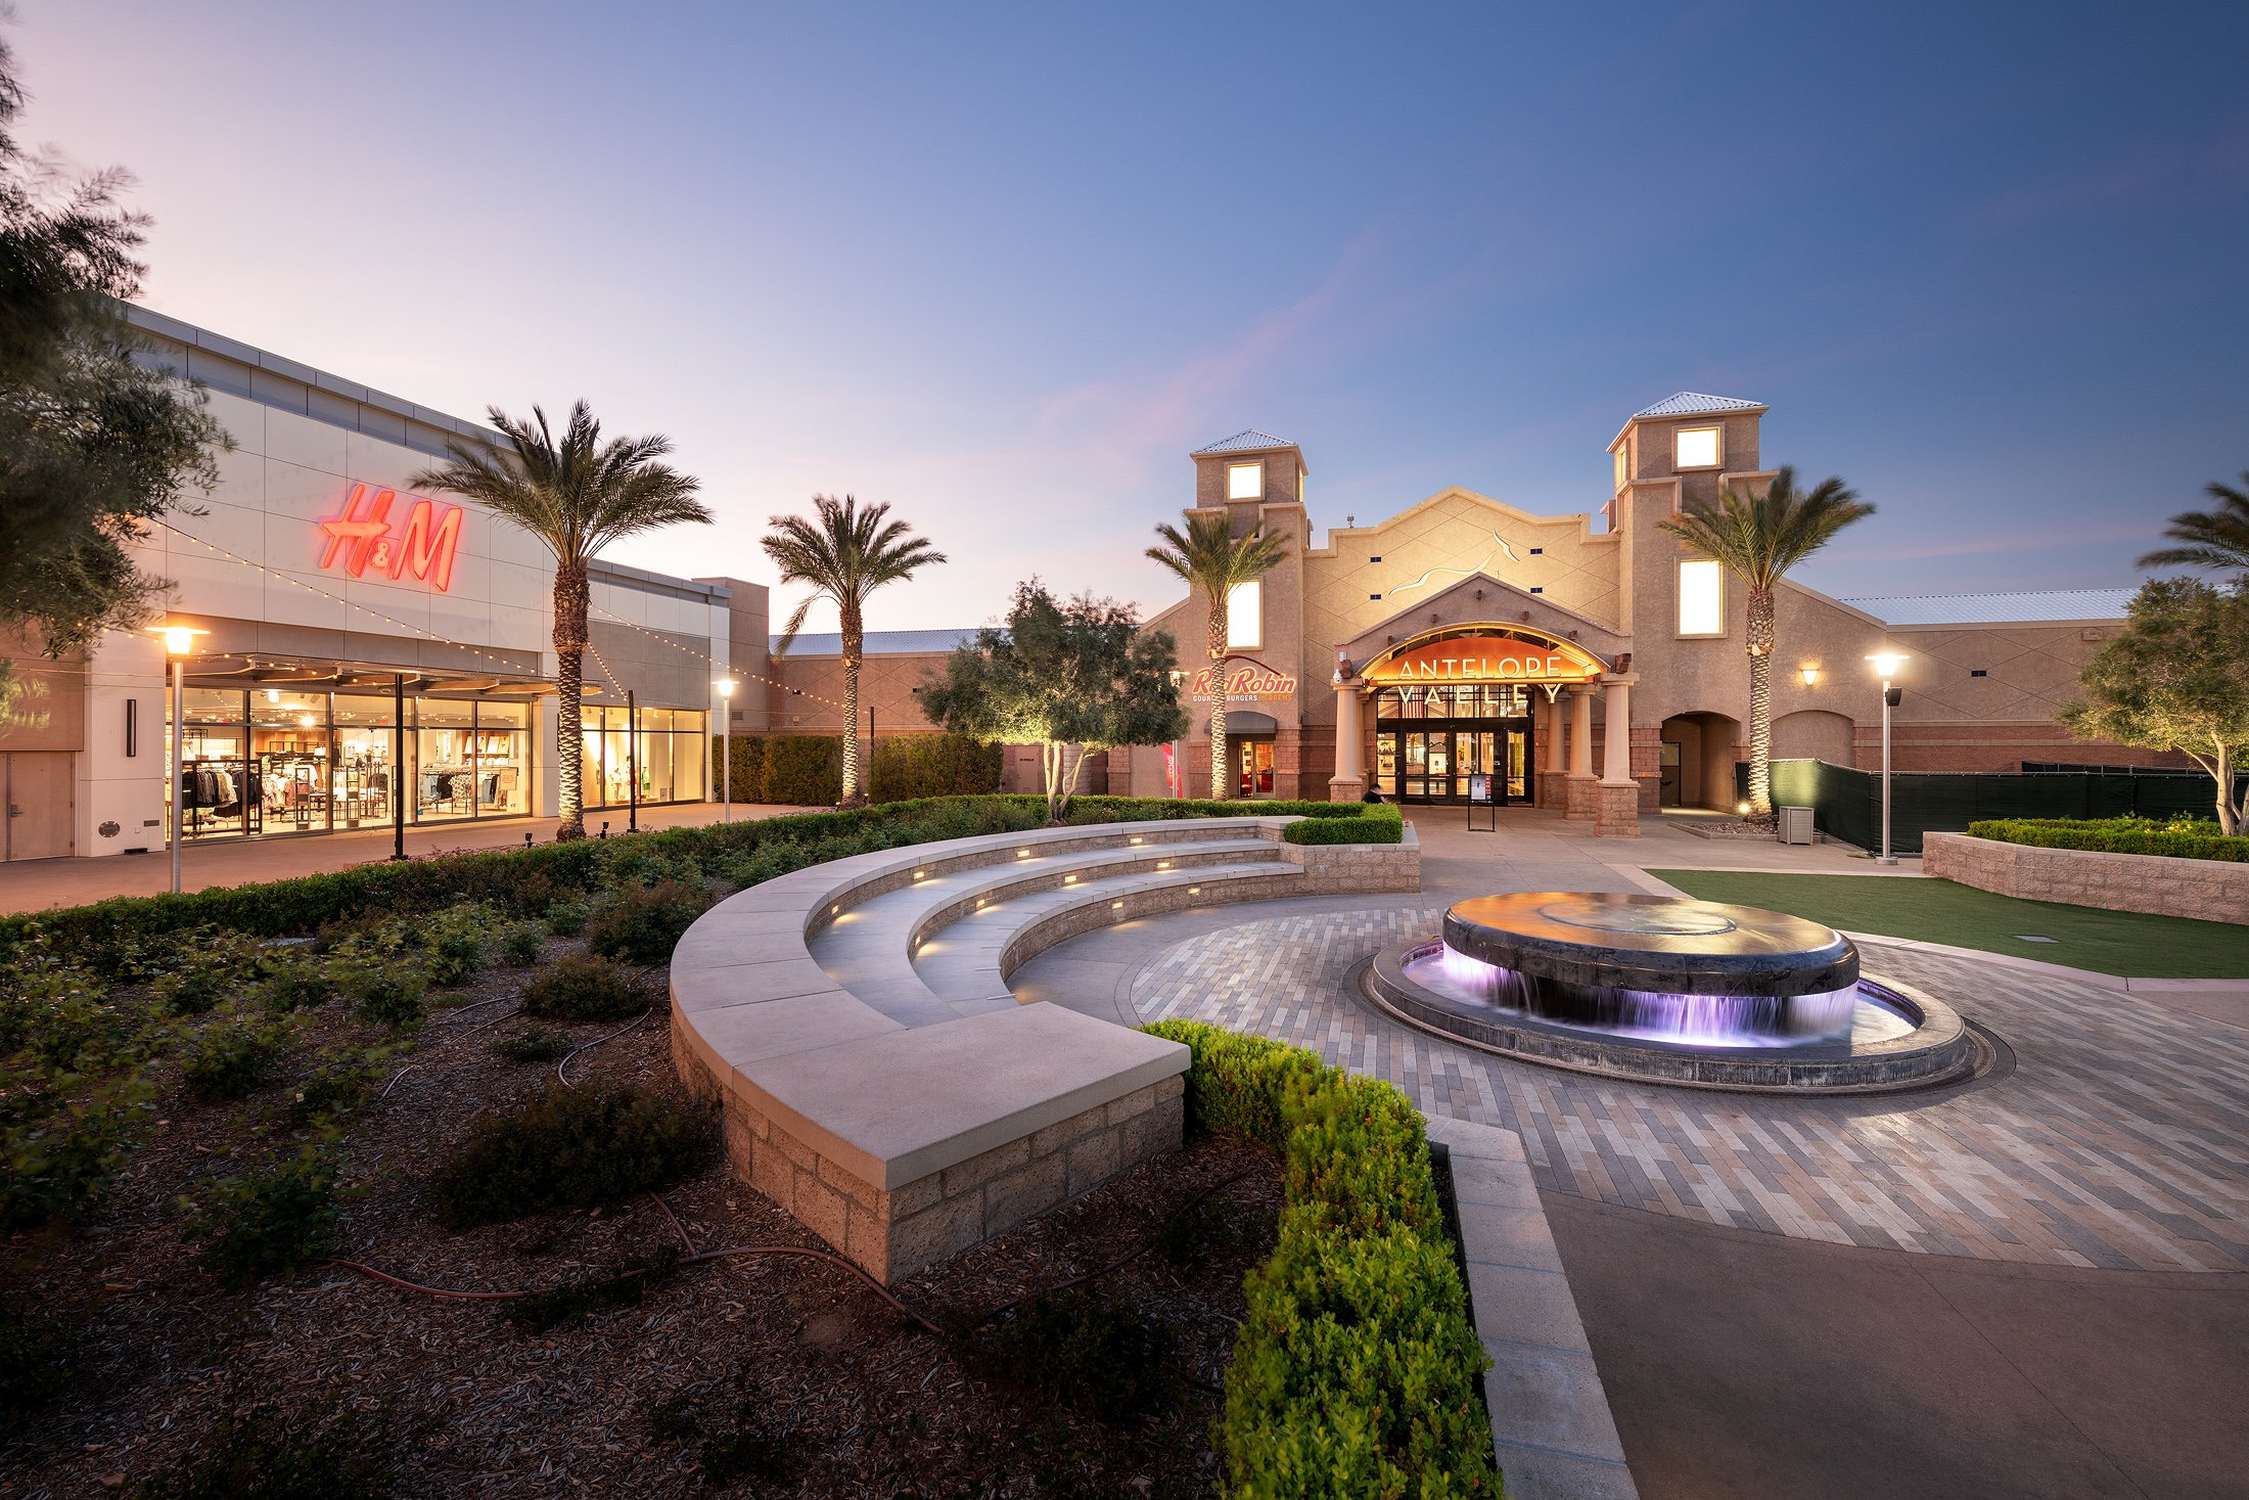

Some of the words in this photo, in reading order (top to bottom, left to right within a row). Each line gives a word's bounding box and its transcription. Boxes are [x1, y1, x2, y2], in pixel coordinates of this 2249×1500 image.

[320, 484, 463, 592] H&M
[1400, 656, 1561, 679] ANTELOPE
[1192, 667, 1237, 694] Rd
[1234, 667, 1297, 694] Robin
[1193, 694, 1217, 702] GOUR
[1226, 694, 1258, 702] BURGERS
[1398, 684, 1563, 704] VALLEY
